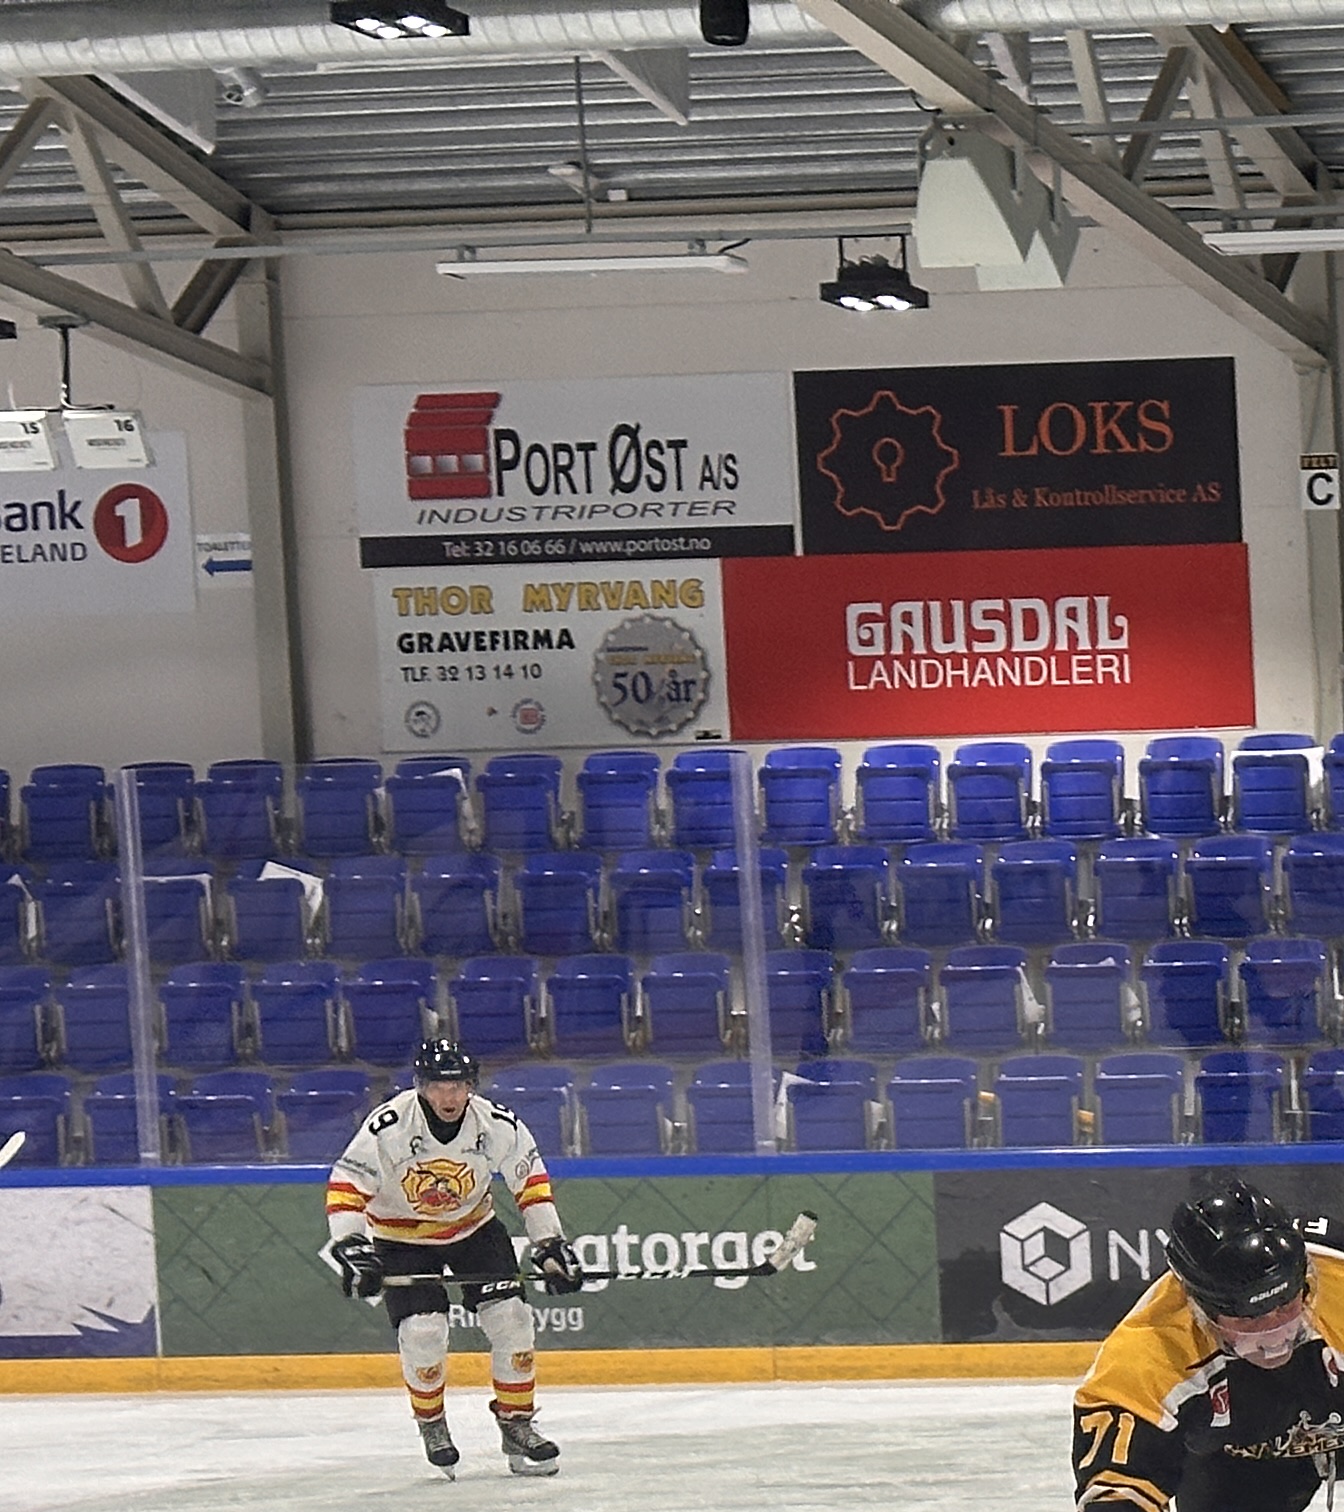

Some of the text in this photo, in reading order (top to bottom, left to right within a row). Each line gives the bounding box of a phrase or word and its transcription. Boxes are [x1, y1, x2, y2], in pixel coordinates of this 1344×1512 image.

[22, 422, 40, 434] 15
[114, 419, 135, 432] 16
[997, 400, 1174, 457] LOKS
[493, 422, 739, 497] PORT ØST A/S
[973, 482, 1221, 510] Lås & Kontrollservice AS
[1306, 472, 1334, 505] C
[0, 489, 84, 532] ank
[417, 500, 737, 525] INDUSTRIPORTER
[0, 542, 88, 565] ELAND
[475, 541, 494, 557] 32
[500, 540, 518, 556] 16
[520, 538, 542, 556] 06
[544, 537, 566, 555] 66
[578, 535, 712, 557] www.portost.no
[392, 578, 705, 617] THOR MYRVANG
[398, 628, 576, 653] GRAVEFIRMA
[846, 596, 1129, 656] GAUSDAL
[438, 665, 459, 681] 32
[466, 664, 487, 681] 13
[493, 663, 514, 680] 14
[522, 663, 542, 680] 10
[612, 669, 697, 707] 50 år
[848, 654, 1131, 690] LANDHANDLERI
[1079, 1410, 1136, 1470] 71
